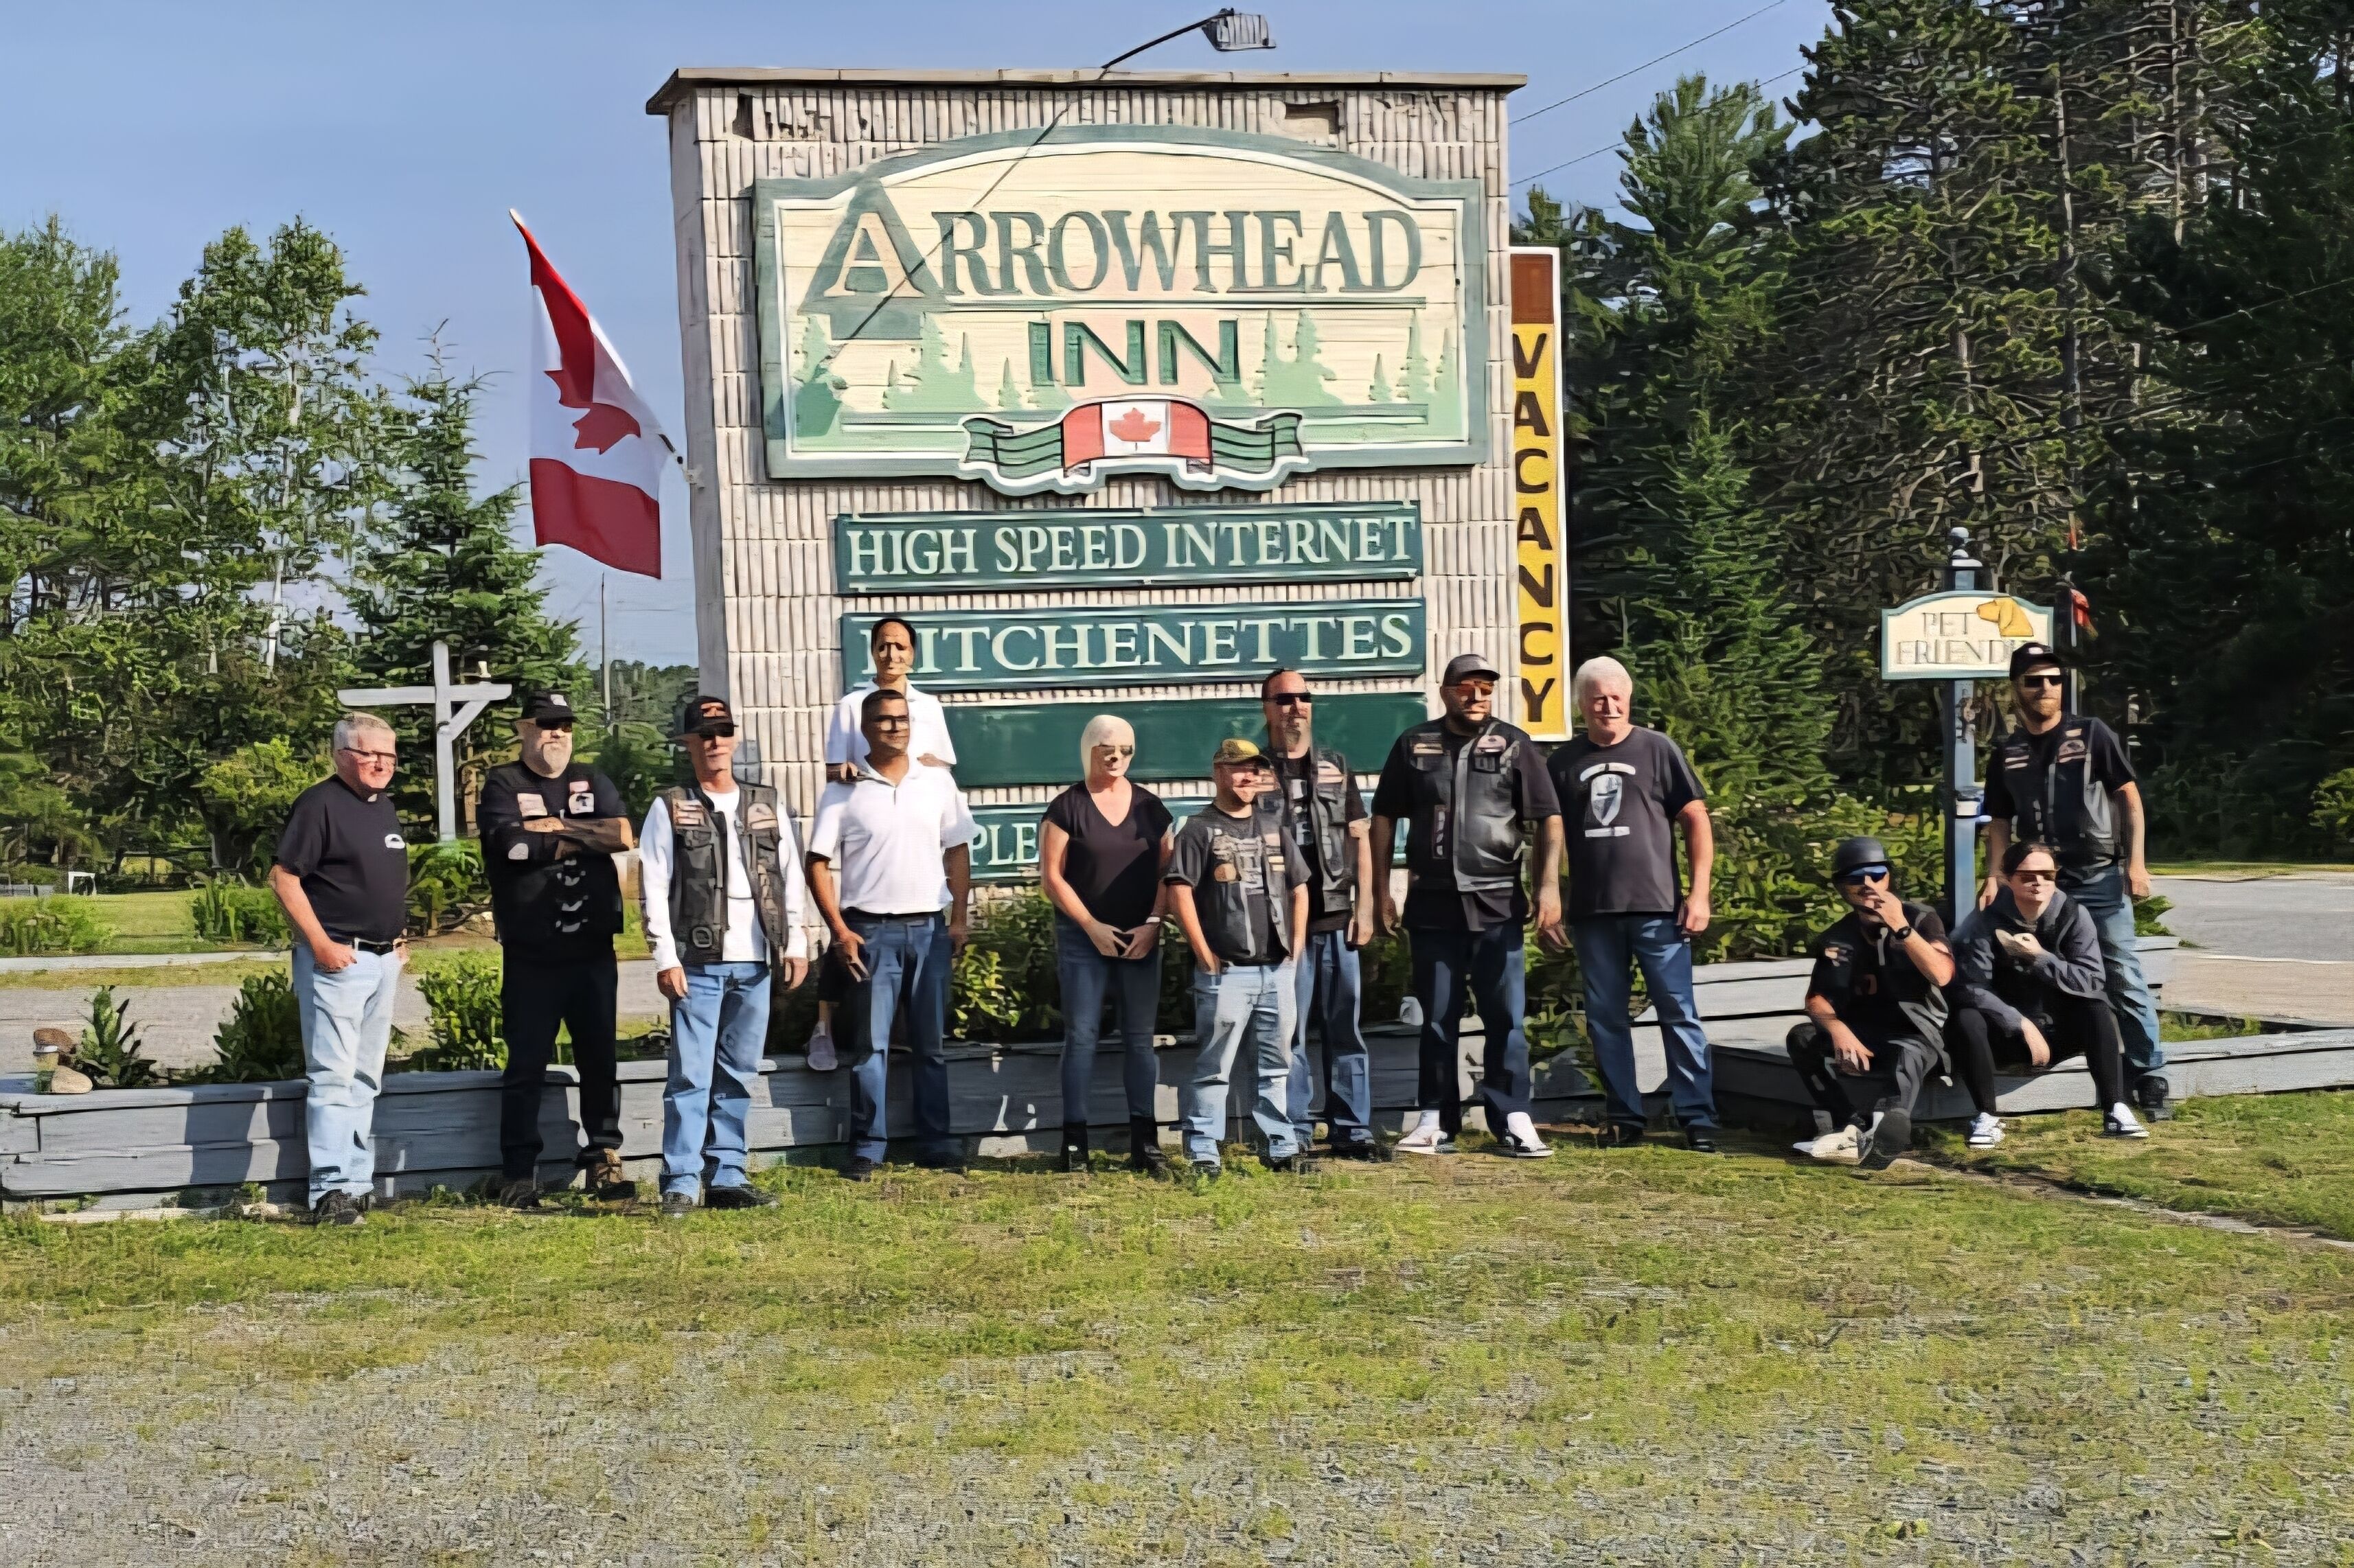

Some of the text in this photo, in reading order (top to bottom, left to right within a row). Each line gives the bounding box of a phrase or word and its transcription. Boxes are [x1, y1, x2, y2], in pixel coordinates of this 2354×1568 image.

[824, 209, 1421, 298] ARROWHEAD
[1029, 318, 1242, 387] INN
[848, 516, 1416, 577] HIGH SPEED INTERNET
[1513, 332, 1555, 723] VACANCY
